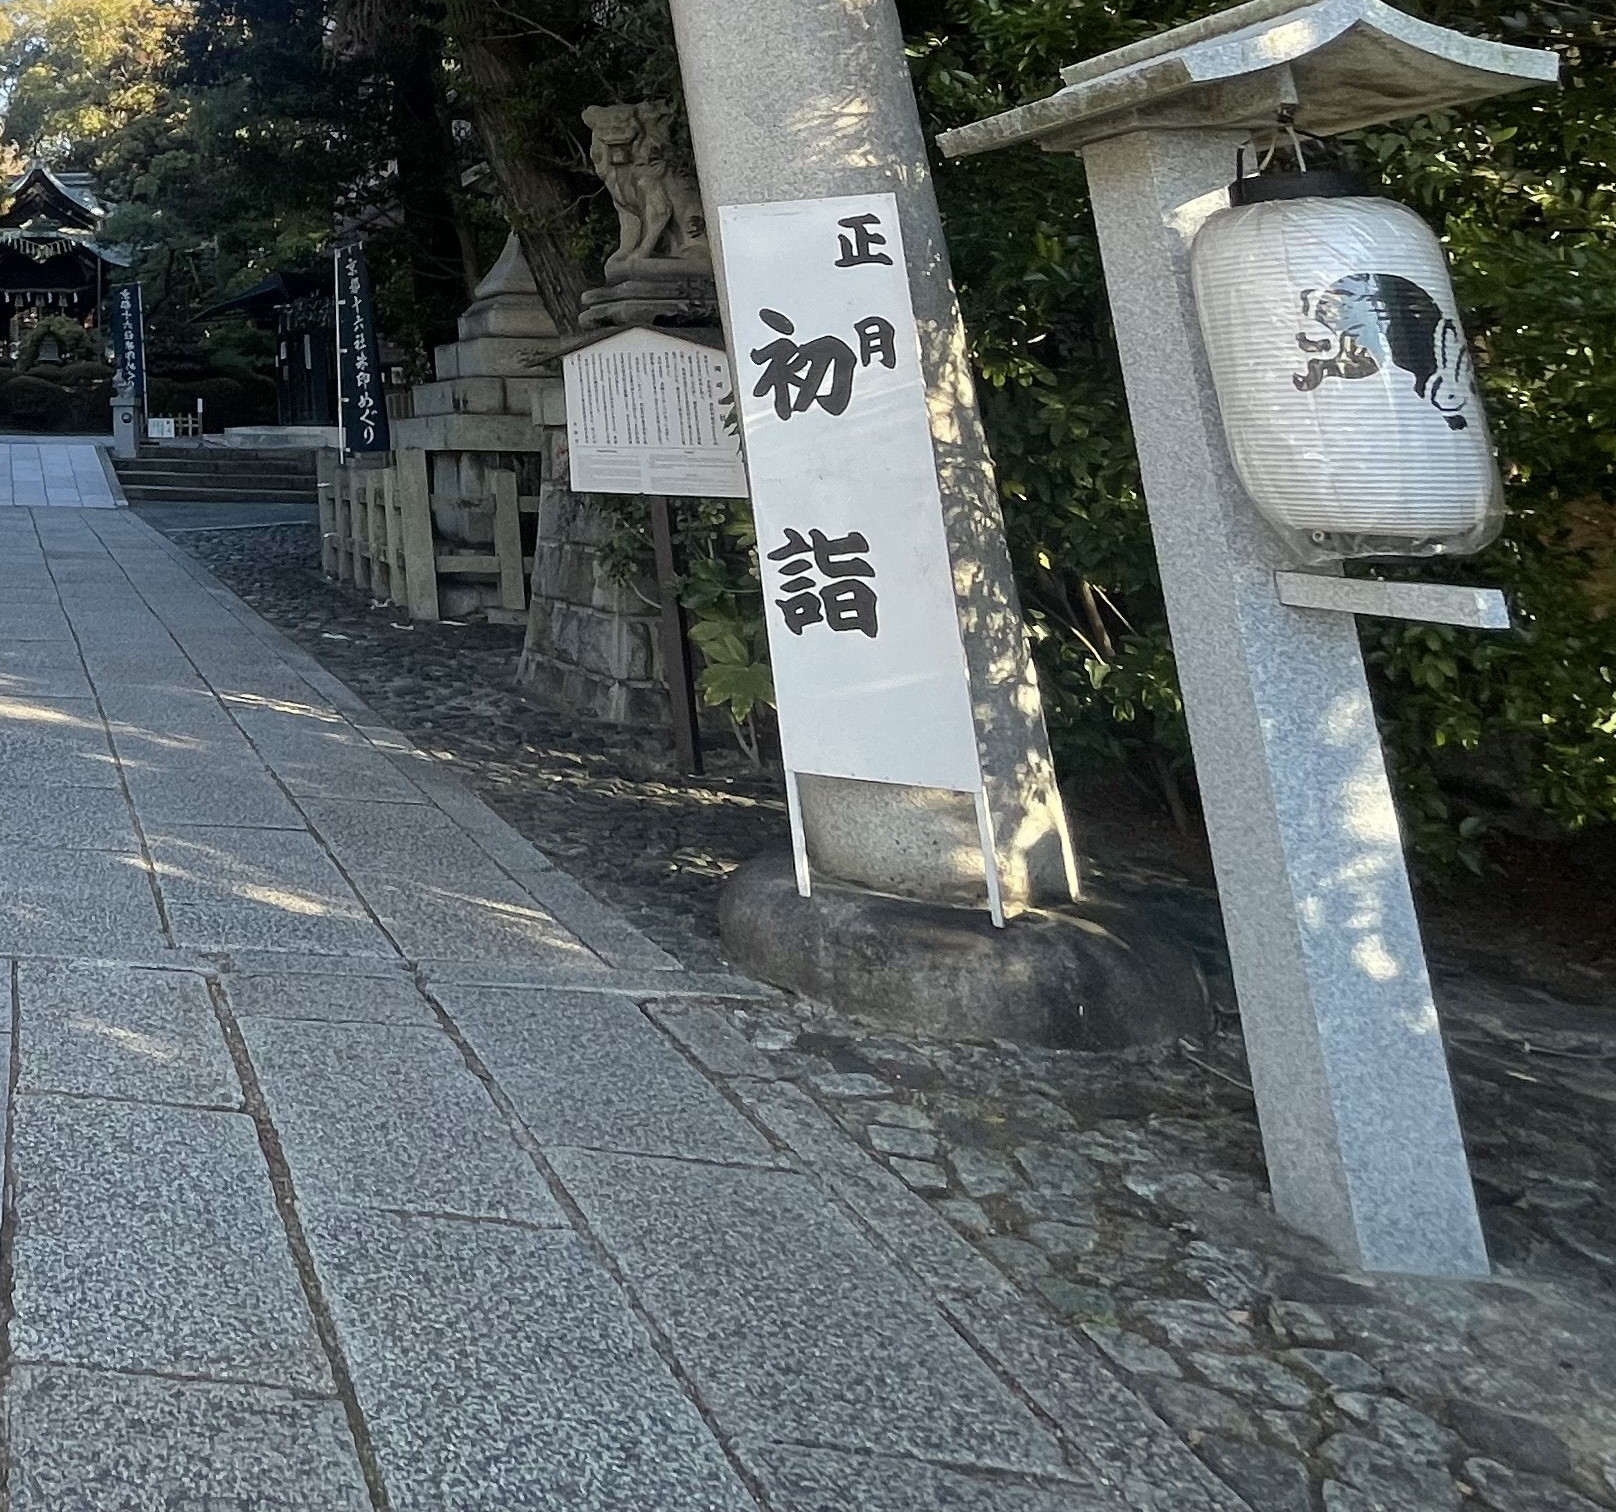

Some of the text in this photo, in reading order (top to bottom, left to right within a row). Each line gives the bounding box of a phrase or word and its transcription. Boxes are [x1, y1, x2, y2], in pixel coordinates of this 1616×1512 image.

[345, 258, 378, 445] 京都十六社朱印めぐり
[834, 213, 897, 370] 正月
[750, 308, 878, 639] 初詣
